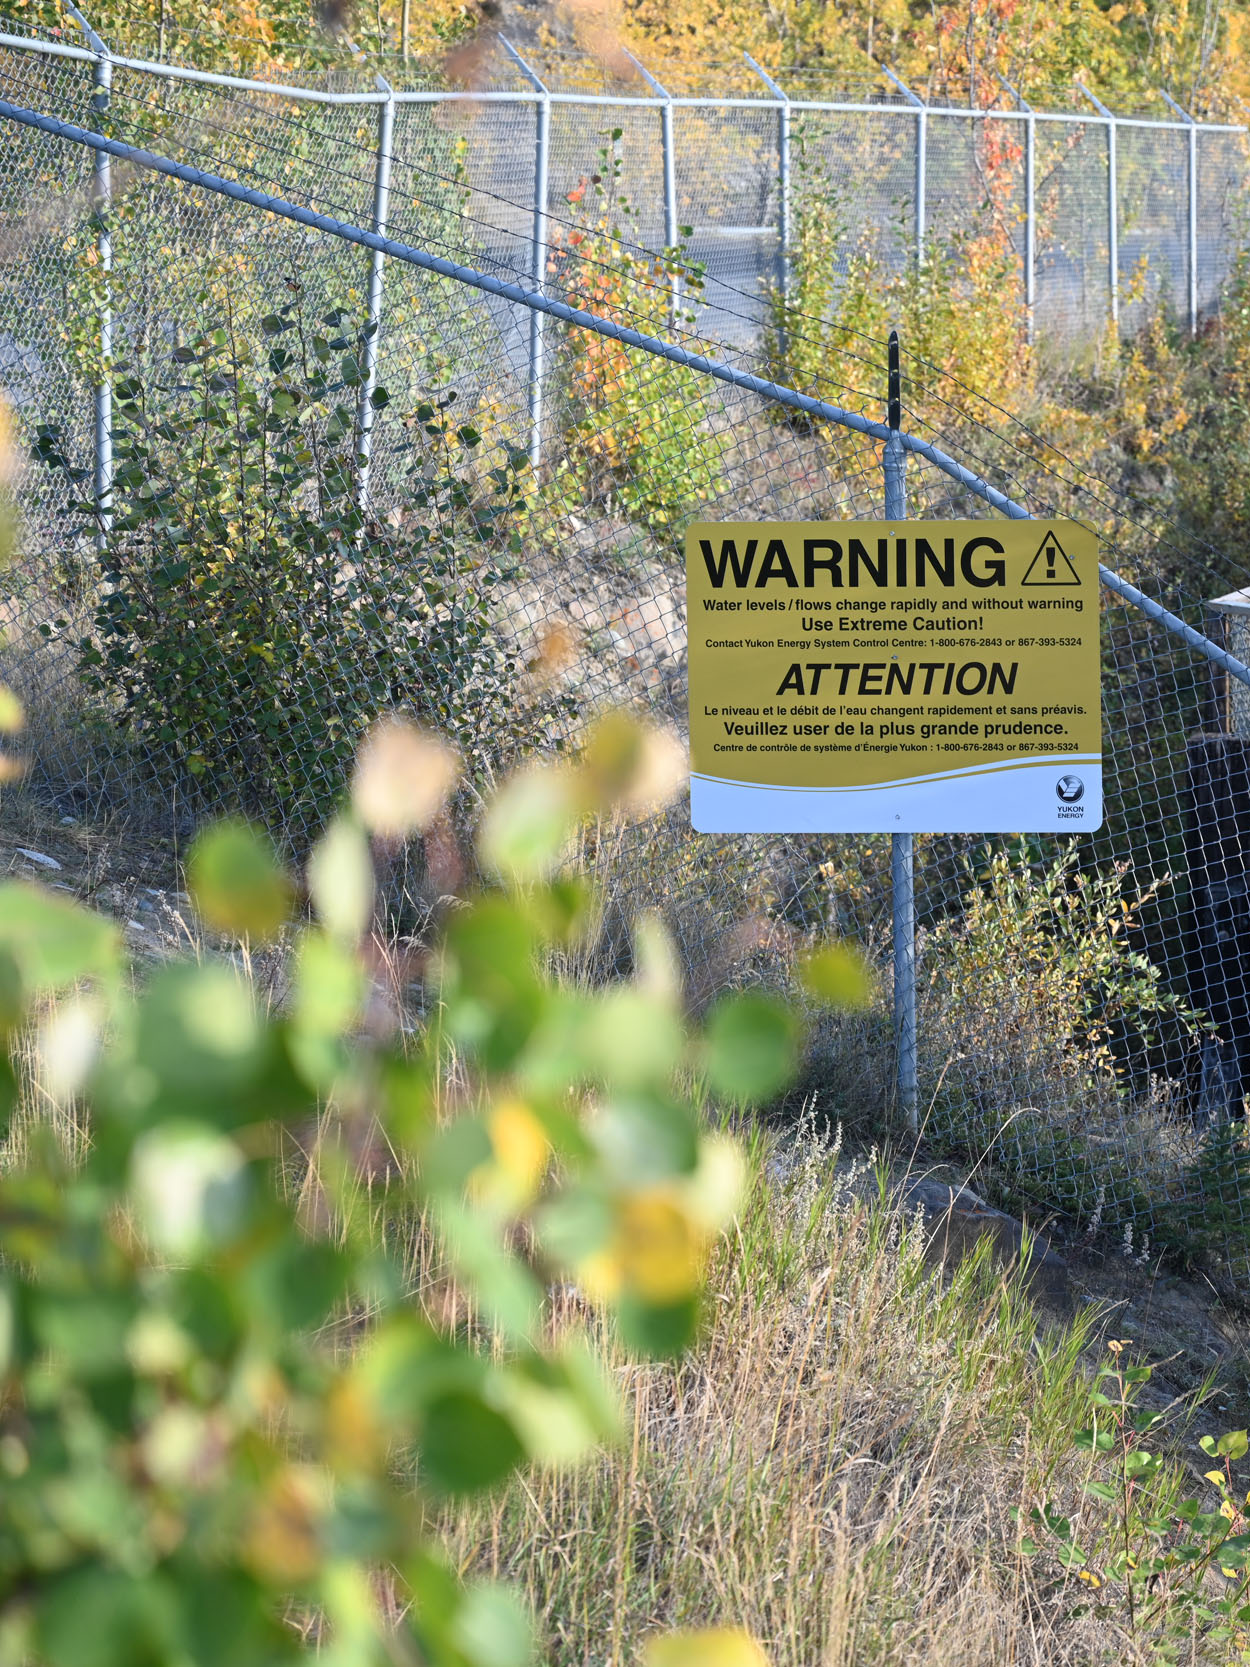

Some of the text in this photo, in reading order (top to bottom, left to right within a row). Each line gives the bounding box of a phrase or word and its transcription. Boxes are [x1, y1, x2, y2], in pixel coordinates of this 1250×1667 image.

[699, 536, 1006, 589] WARNING
[702, 599, 743, 612] Water
[746, 598, 786, 611] levels
[835, 598, 887, 614] change
[890, 597, 938, 614] rapidly
[941, 597, 968, 610] and
[971, 597, 1024, 610] without
[1027, 596, 1084, 613] warning
[801, 616, 984, 632] Use Extreme Caution!
[705, 637, 1082, 650] Contact Yukon Energy System Control Centre: 1-800-676-2843 or 867-393-5324
[775, 661, 1019, 696] ATTENTION
[704, 705, 719, 716] Le
[721, 705, 760, 716] niveau
[762, 706, 774, 716] et
[776, 705, 787, 716] le
[789, 704, 819, 716] débit
[822, 705, 837, 716] de
[870, 705, 925, 718] changent
[927, 704, 993, 718] rapidement
[995, 705, 1008, 715] et
[1009, 706, 1038, 715] sans
[1041, 703, 1087, 718] préavis.
[723, 720, 1069, 739] Veuillez user de la plus grande prudence.
[713, 743, 744, 752] Centre
[745, 743, 758, 752] de
[759, 742, 798, 752] contrôle
[799, 743, 812, 752] de
[813, 743, 853, 754] système
[935, 742, 1005, 752] 1-800-676-2843
[1006, 744, 1017, 752] or
[1018, 742, 1079, 752] 867-393-5324
